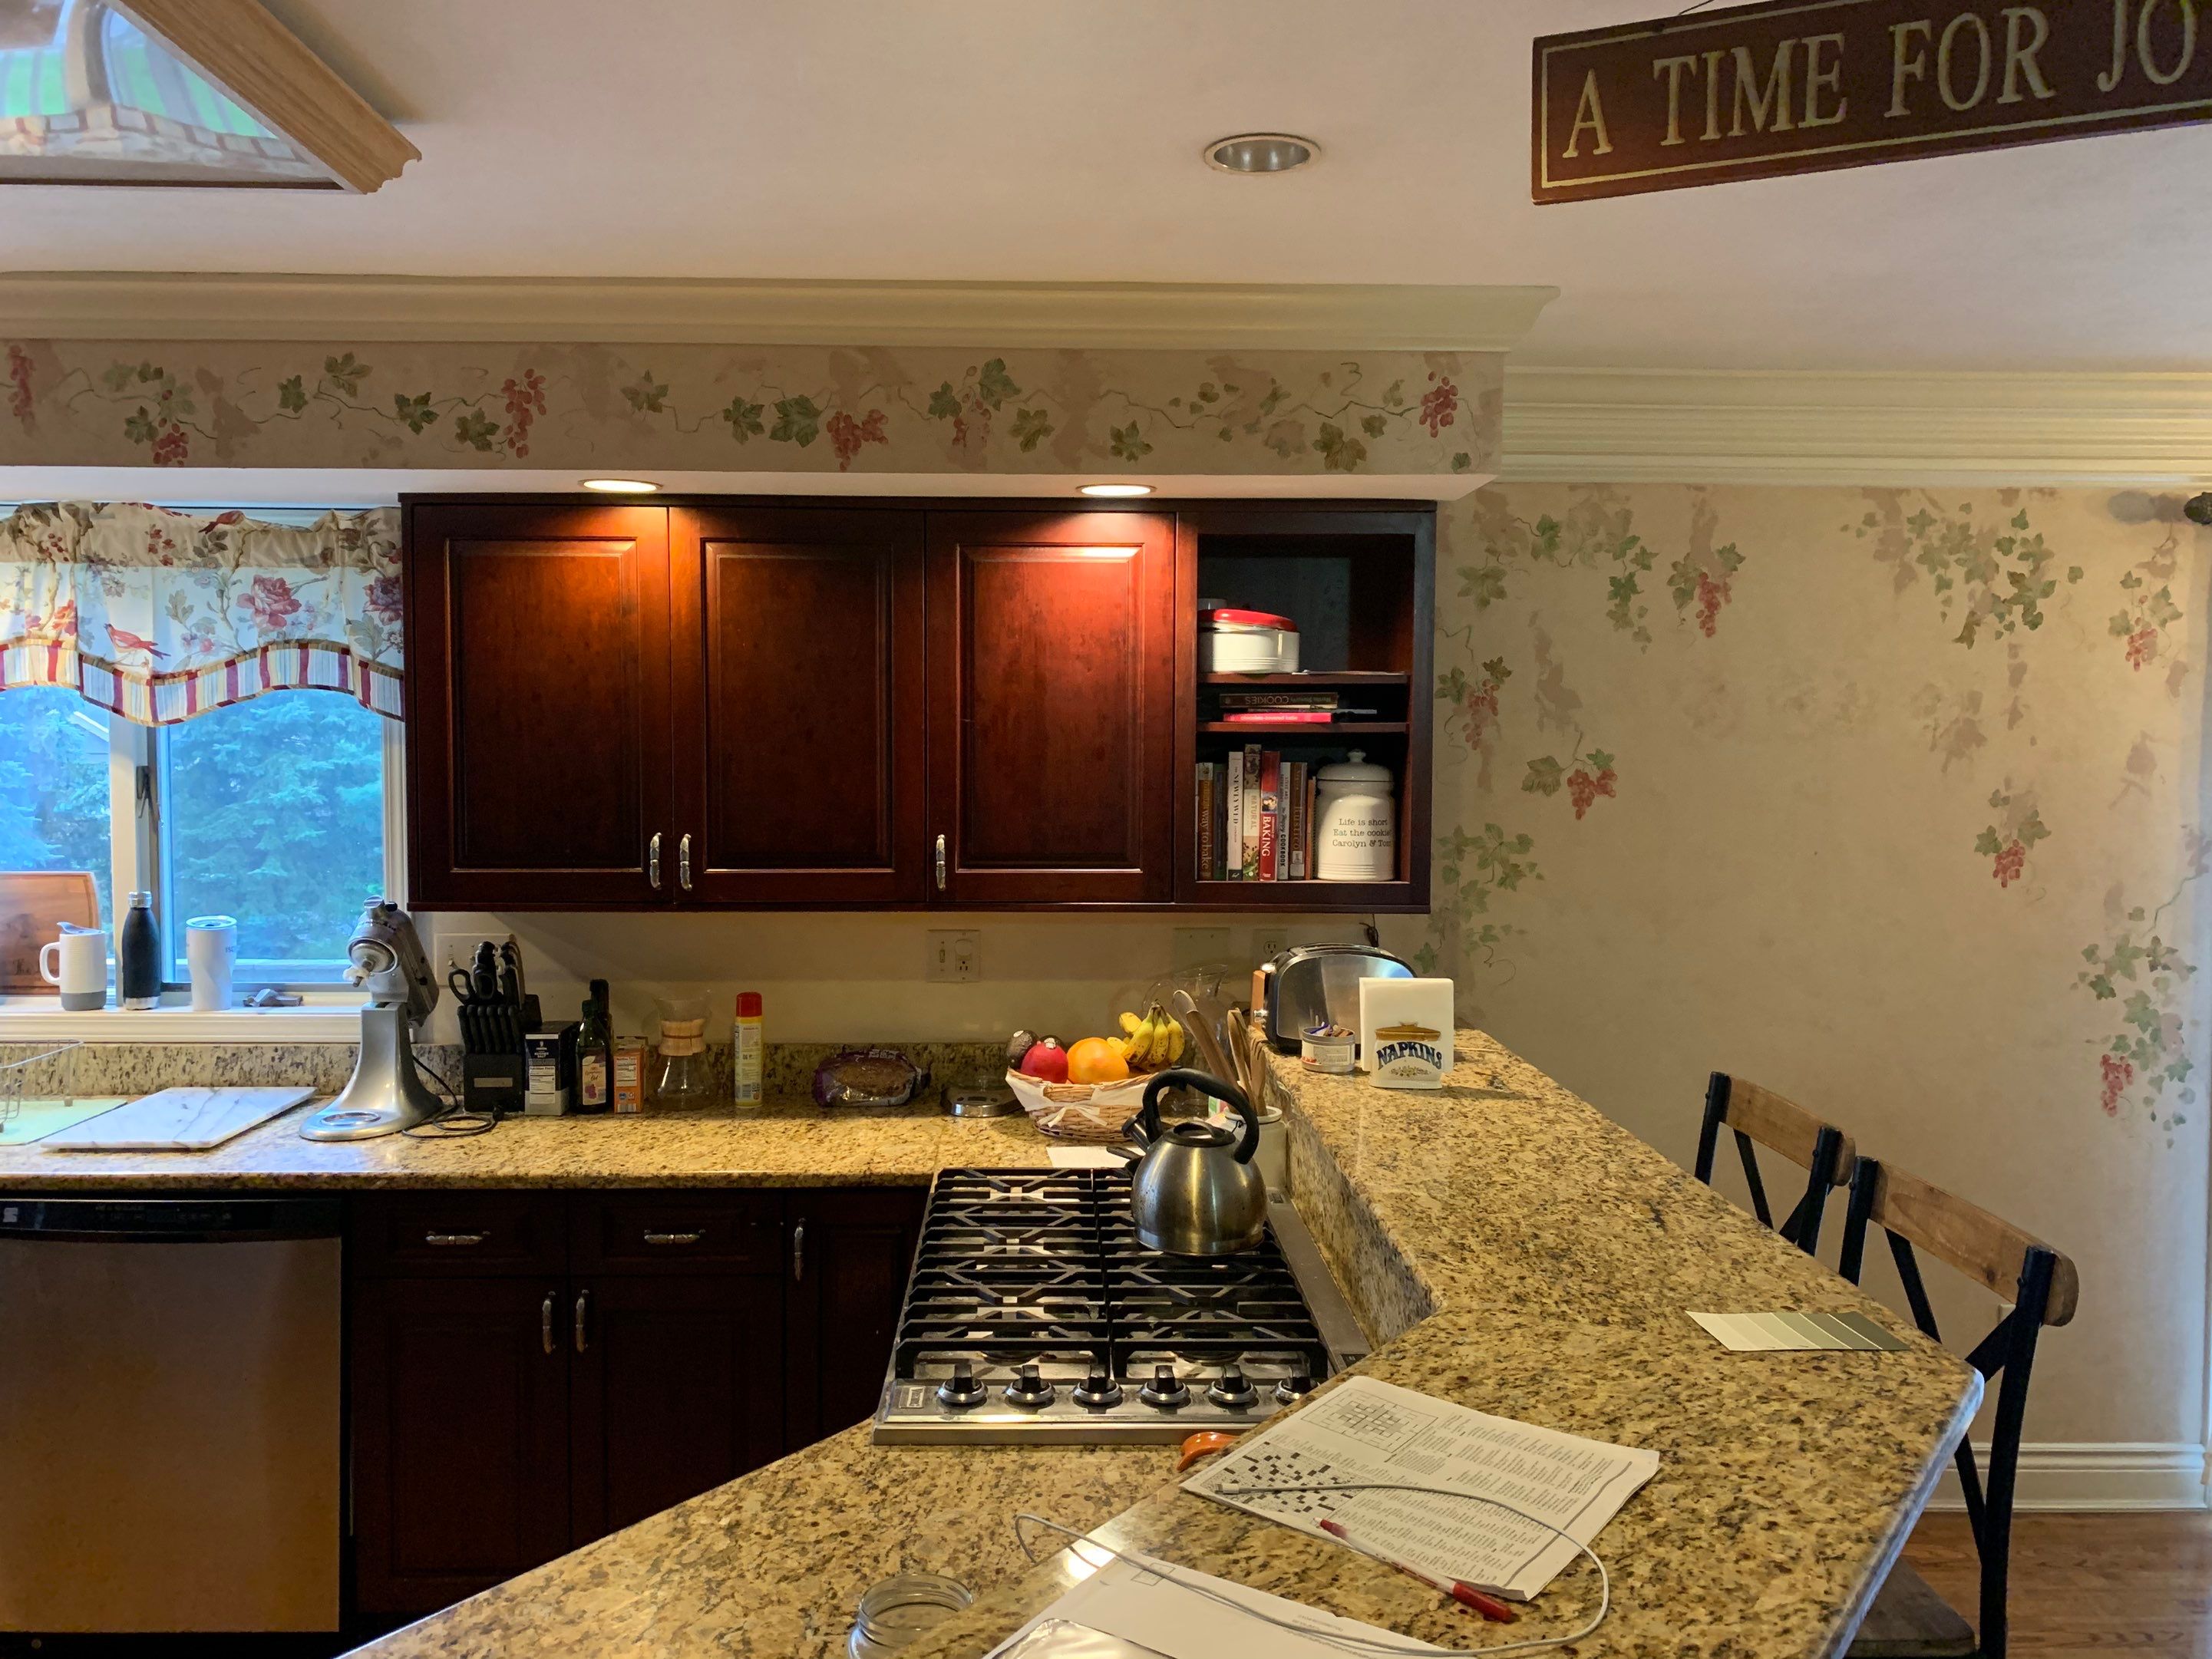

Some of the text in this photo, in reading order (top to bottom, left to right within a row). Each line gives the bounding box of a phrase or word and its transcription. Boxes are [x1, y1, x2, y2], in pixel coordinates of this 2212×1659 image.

[1562, 0, 2197, 159] A TIME FOR JO
[1245, 695, 1289, 704] COOKIES
[1200, 810, 1210, 830] way
[1200, 832, 1210, 843] to
[1262, 816, 1271, 856] BAKING
[1332, 839, 1366, 848] Carolyn
[1200, 844, 1213, 869] bake
[1376, 1041, 1442, 1070] NAPKINS
